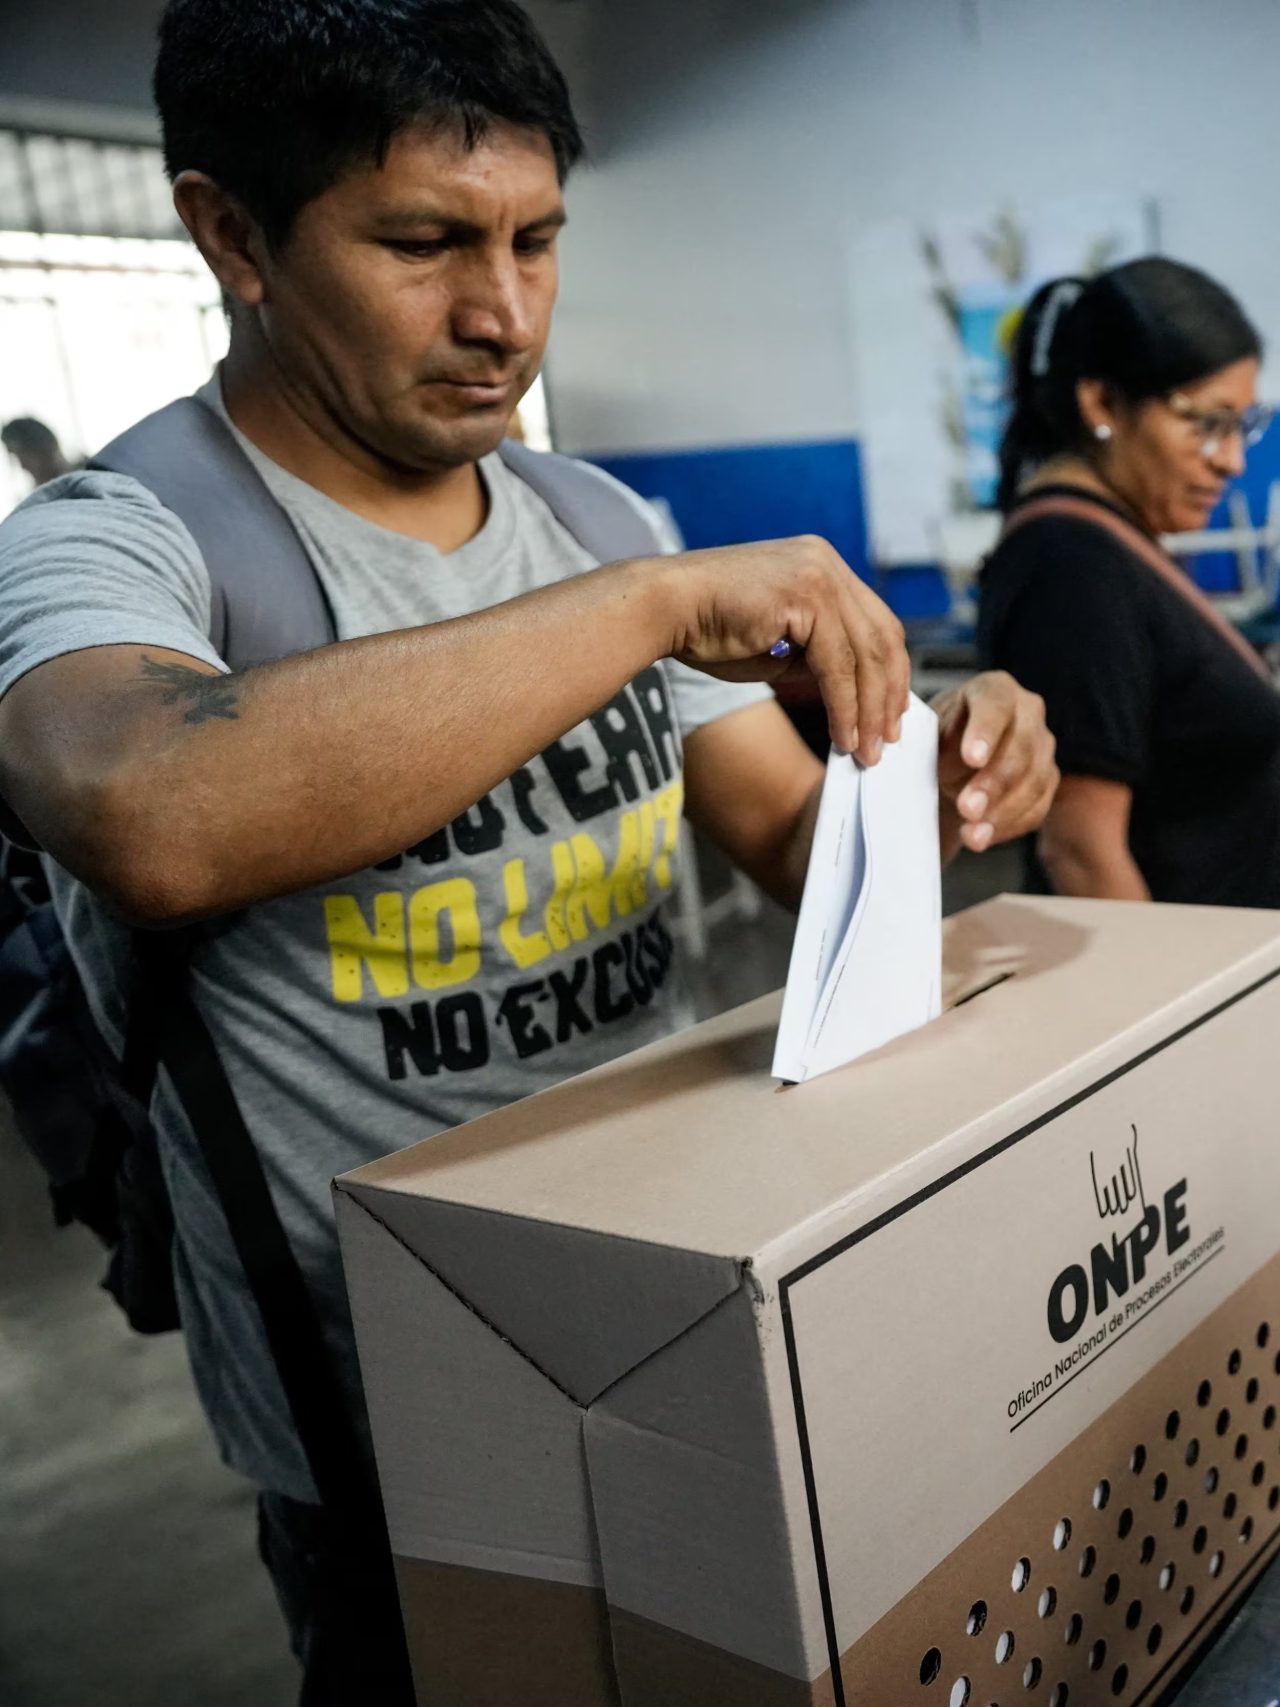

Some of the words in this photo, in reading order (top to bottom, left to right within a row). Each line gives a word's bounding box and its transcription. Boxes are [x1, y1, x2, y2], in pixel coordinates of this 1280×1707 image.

[325, 877, 482, 1003] NO
[377, 991, 490, 1080] NO
[1007, 1372, 1053, 1418] Oficina
[1054, 1323, 1107, 1380] Nacional
[1108, 1313, 1124, 1333] de
[1124, 1271, 1173, 1319] Procesos
[1173, 1226, 1225, 1278] Electorales
[1047, 1177, 1191, 1344] ONPE
